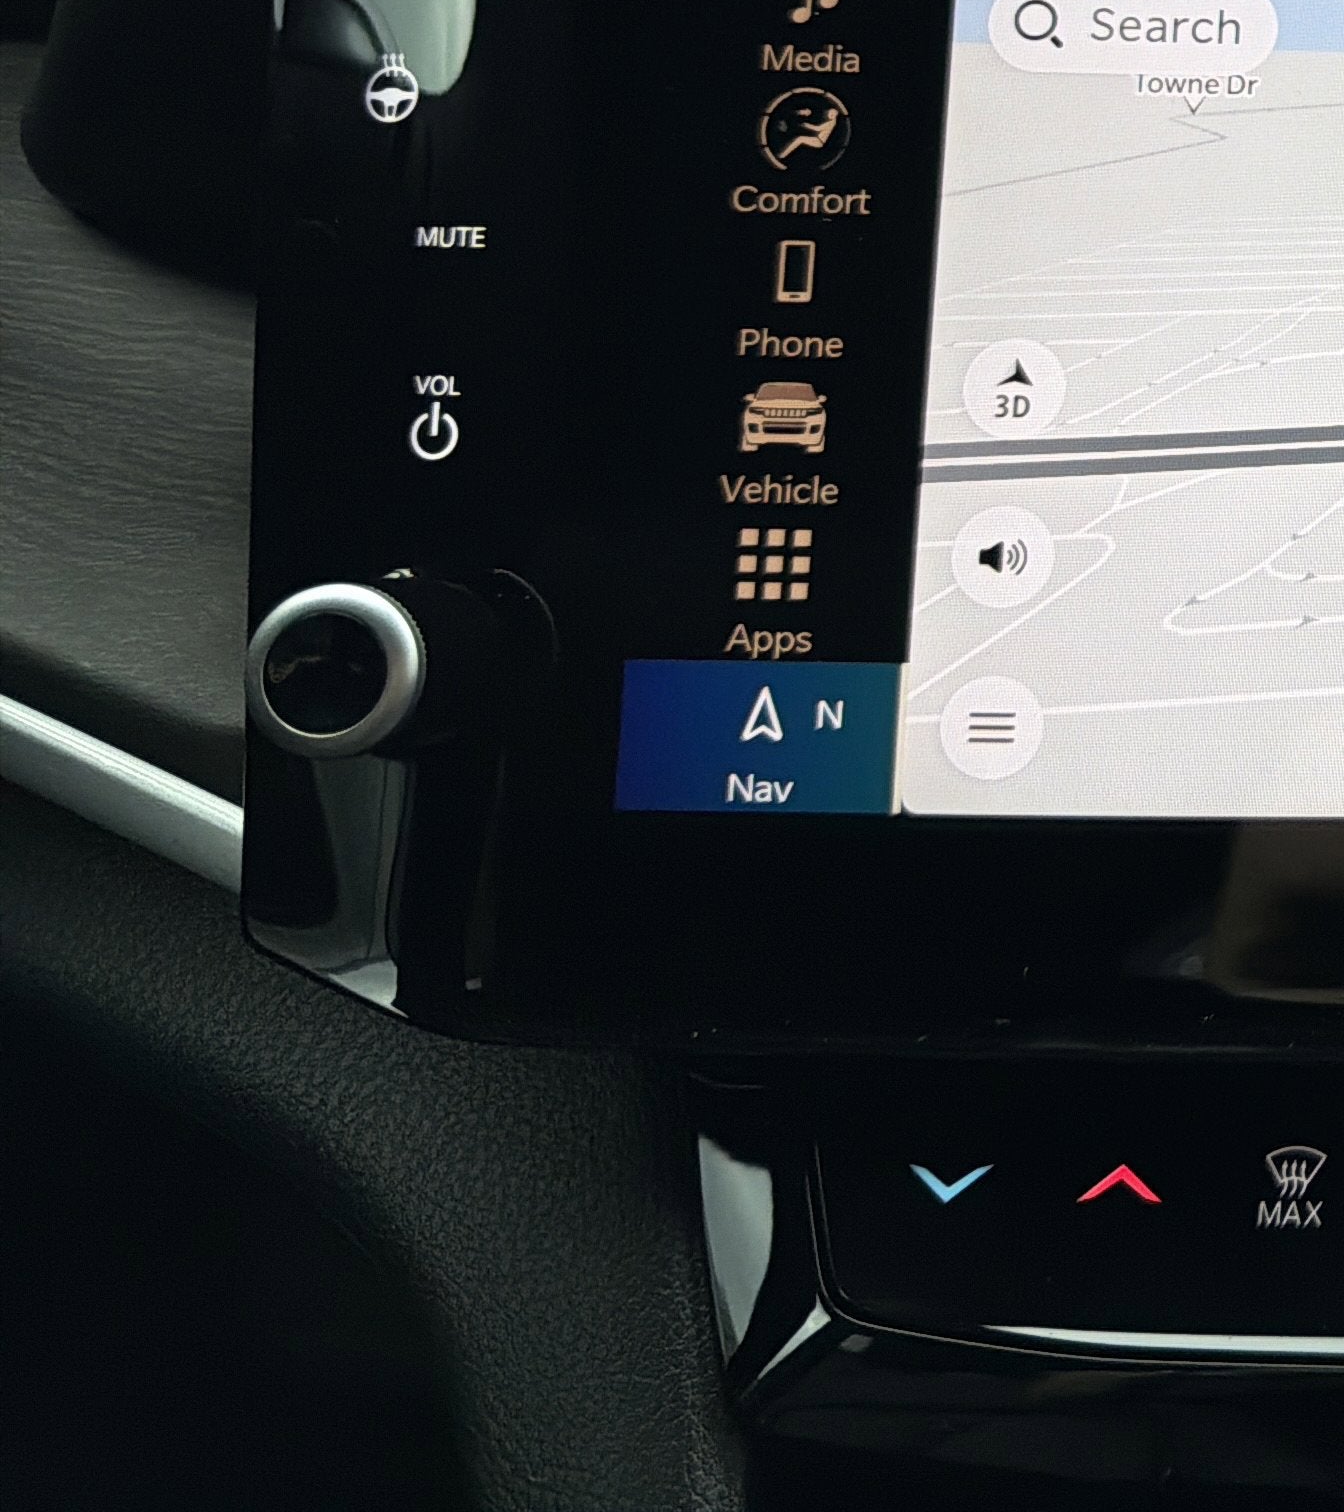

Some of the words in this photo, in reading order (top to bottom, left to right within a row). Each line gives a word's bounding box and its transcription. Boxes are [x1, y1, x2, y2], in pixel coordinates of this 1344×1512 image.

[1091, 7, 1242, 46] Search
[762, 45, 861, 74] Media
[1228, 75, 1258, 95] Dr
[732, 186, 871, 215] Comfort
[417, 227, 486, 249] MUTE
[738, 328, 844, 359] Phone
[414, 376, 461, 397] VOL
[995, 394, 1031, 419] 3D
[720, 476, 839, 506] Vehicle
[724, 624, 813, 659] Apps
[815, 701, 844, 729] N
[727, 774, 794, 803] Nav
[1257, 1201, 1324, 1228] MAX
